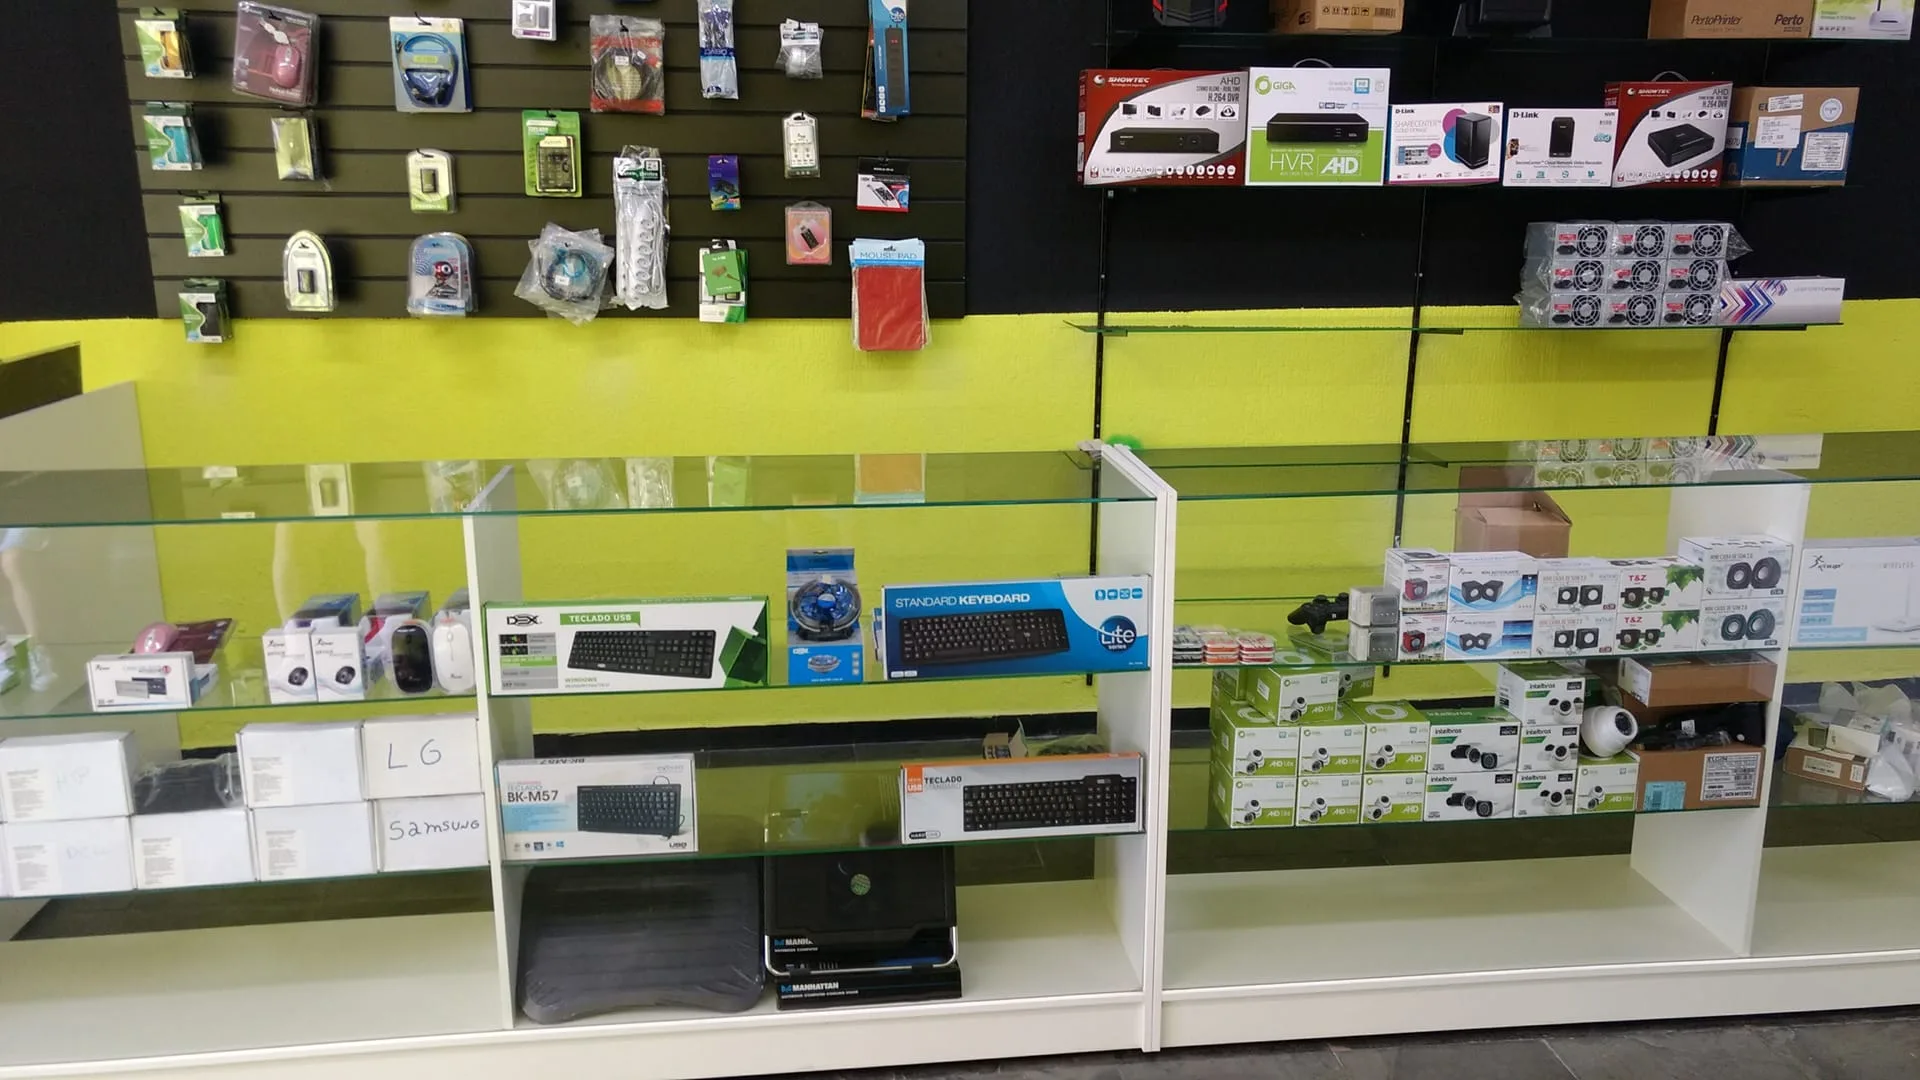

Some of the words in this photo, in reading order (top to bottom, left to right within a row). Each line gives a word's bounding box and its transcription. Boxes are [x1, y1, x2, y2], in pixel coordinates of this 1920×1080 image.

[1690, 13, 1743, 26] PertoPrinter
[1774, 13, 1804, 26] Perto
[1107, 76, 1151, 84] SHOWTEC
[1219, 76, 1241, 86] AHD
[1272, 81, 1296, 91] GIGA
[1712, 88, 1729, 96] AHD
[1513, 111, 1539, 119] D-Link
[1270, 152, 1314, 171] HVR
[1320, 156, 1359, 175] AHD
[860, 251, 896, 259] MOUSE
[897, 251, 918, 259] PAD
[1628, 574, 1648, 582] T&Z
[895, 595, 958, 609] STANDARD
[959, 592, 1031, 606] KEYBOARD
[569, 614, 611, 623] TECLADO
[612, 613, 632, 622] USB
[1624, 616, 1643, 624] T&Z
[1101, 624, 1136, 645] Lite
[1406, 754, 1423, 763] AHD
[924, 775, 962, 785] TECLADO
[507, 789, 559, 803] BK-M57
[1402, 805, 1419, 814] AHD
[792, 982, 839, 992] MANHATTAN
